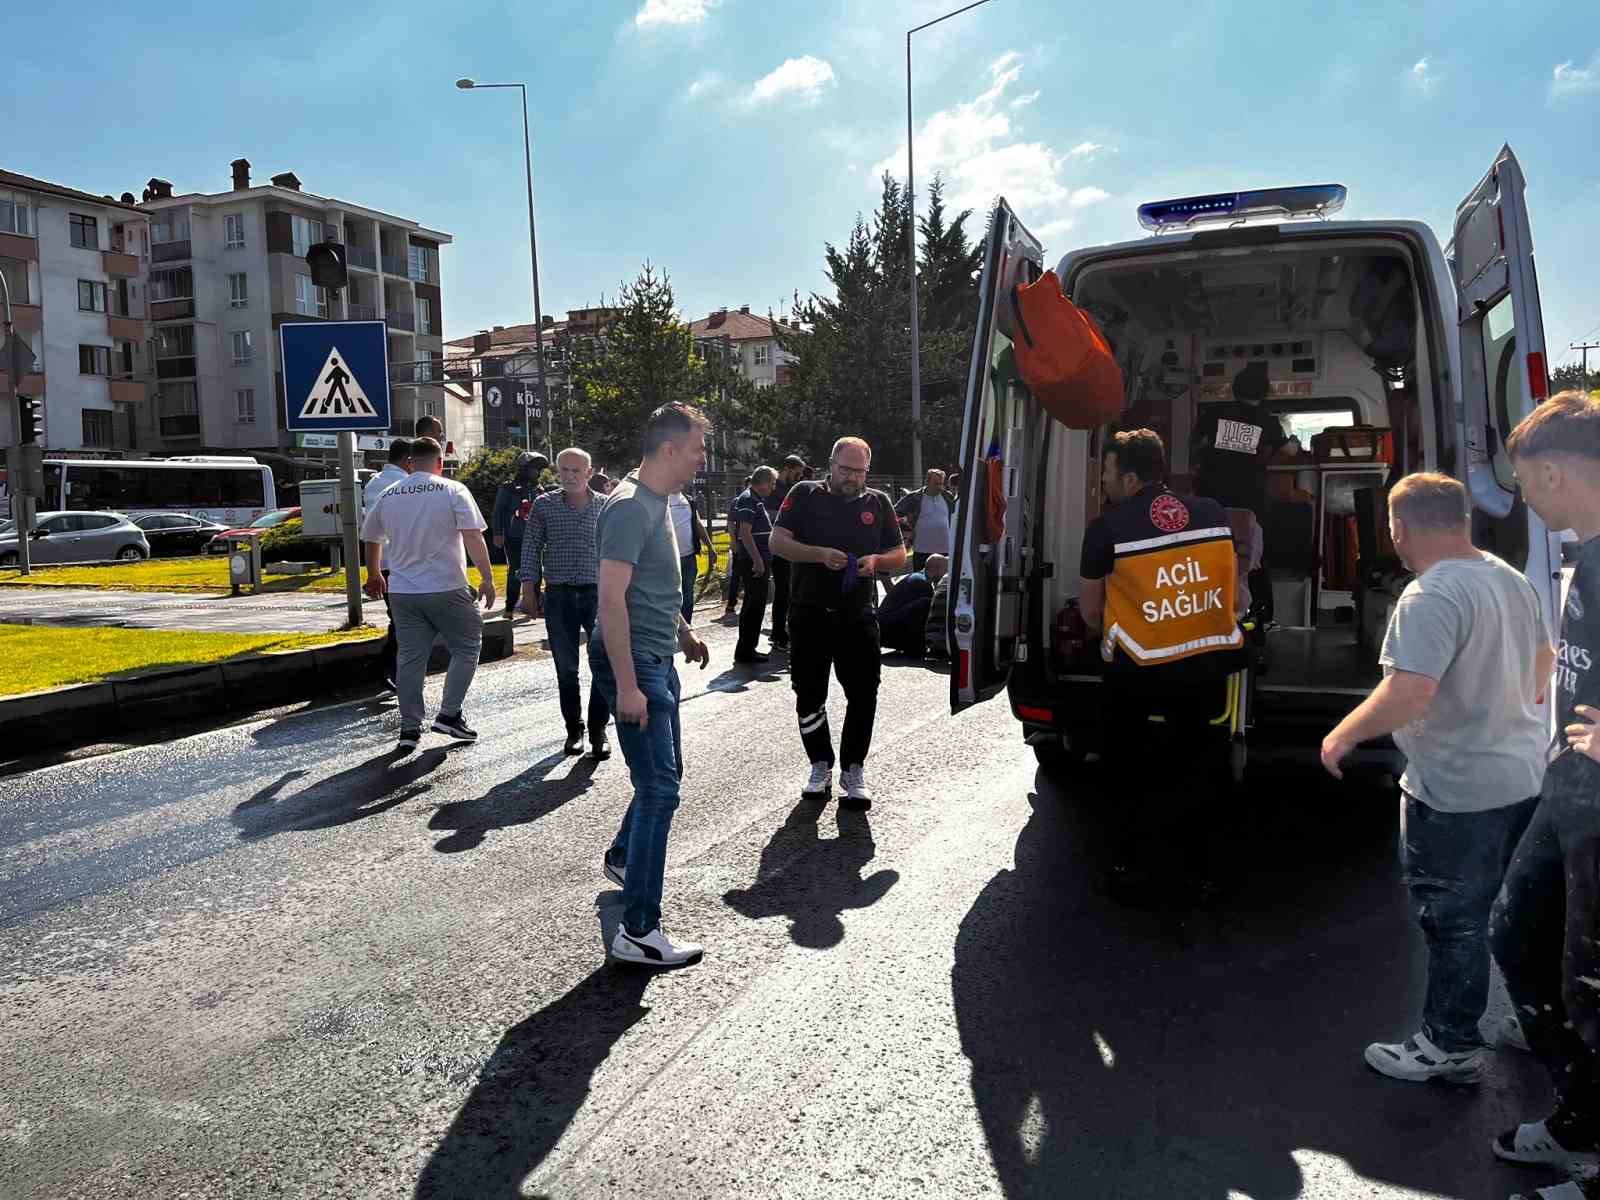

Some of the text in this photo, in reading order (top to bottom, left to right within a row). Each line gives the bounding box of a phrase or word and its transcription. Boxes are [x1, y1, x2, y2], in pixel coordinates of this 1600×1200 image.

[1220, 420, 1257, 446] 112
[1156, 557, 1208, 589] ACİL
[1142, 588, 1222, 623] SAĞLIK
